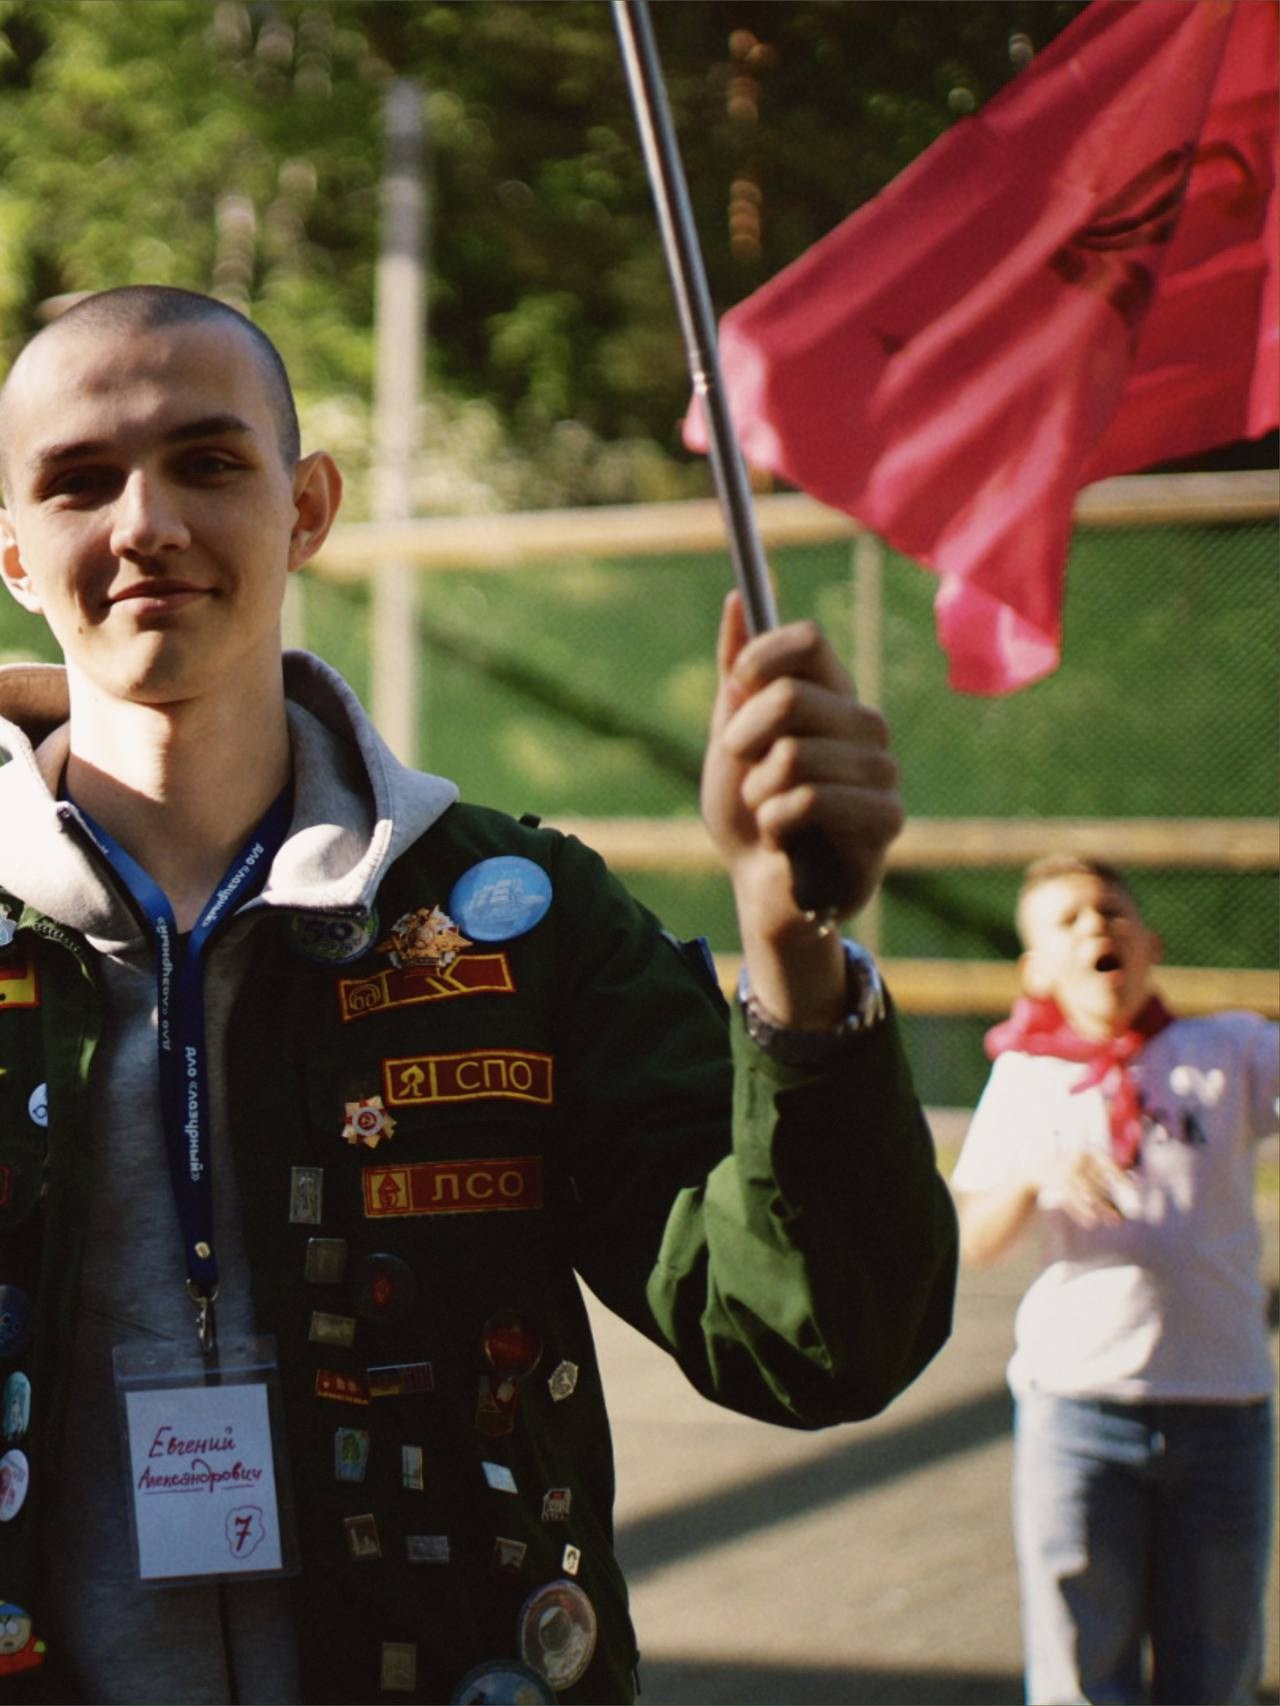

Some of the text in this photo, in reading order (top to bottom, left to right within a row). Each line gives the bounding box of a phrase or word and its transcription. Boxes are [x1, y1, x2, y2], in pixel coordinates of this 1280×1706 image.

[455, 1059, 533, 1091] СПО
[432, 1170, 524, 1201] ЛСО
[148, 1425, 236, 1458] Евгений
[138, 1458, 263, 1494] Александрович
[234, 1514, 253, 1551] 7
